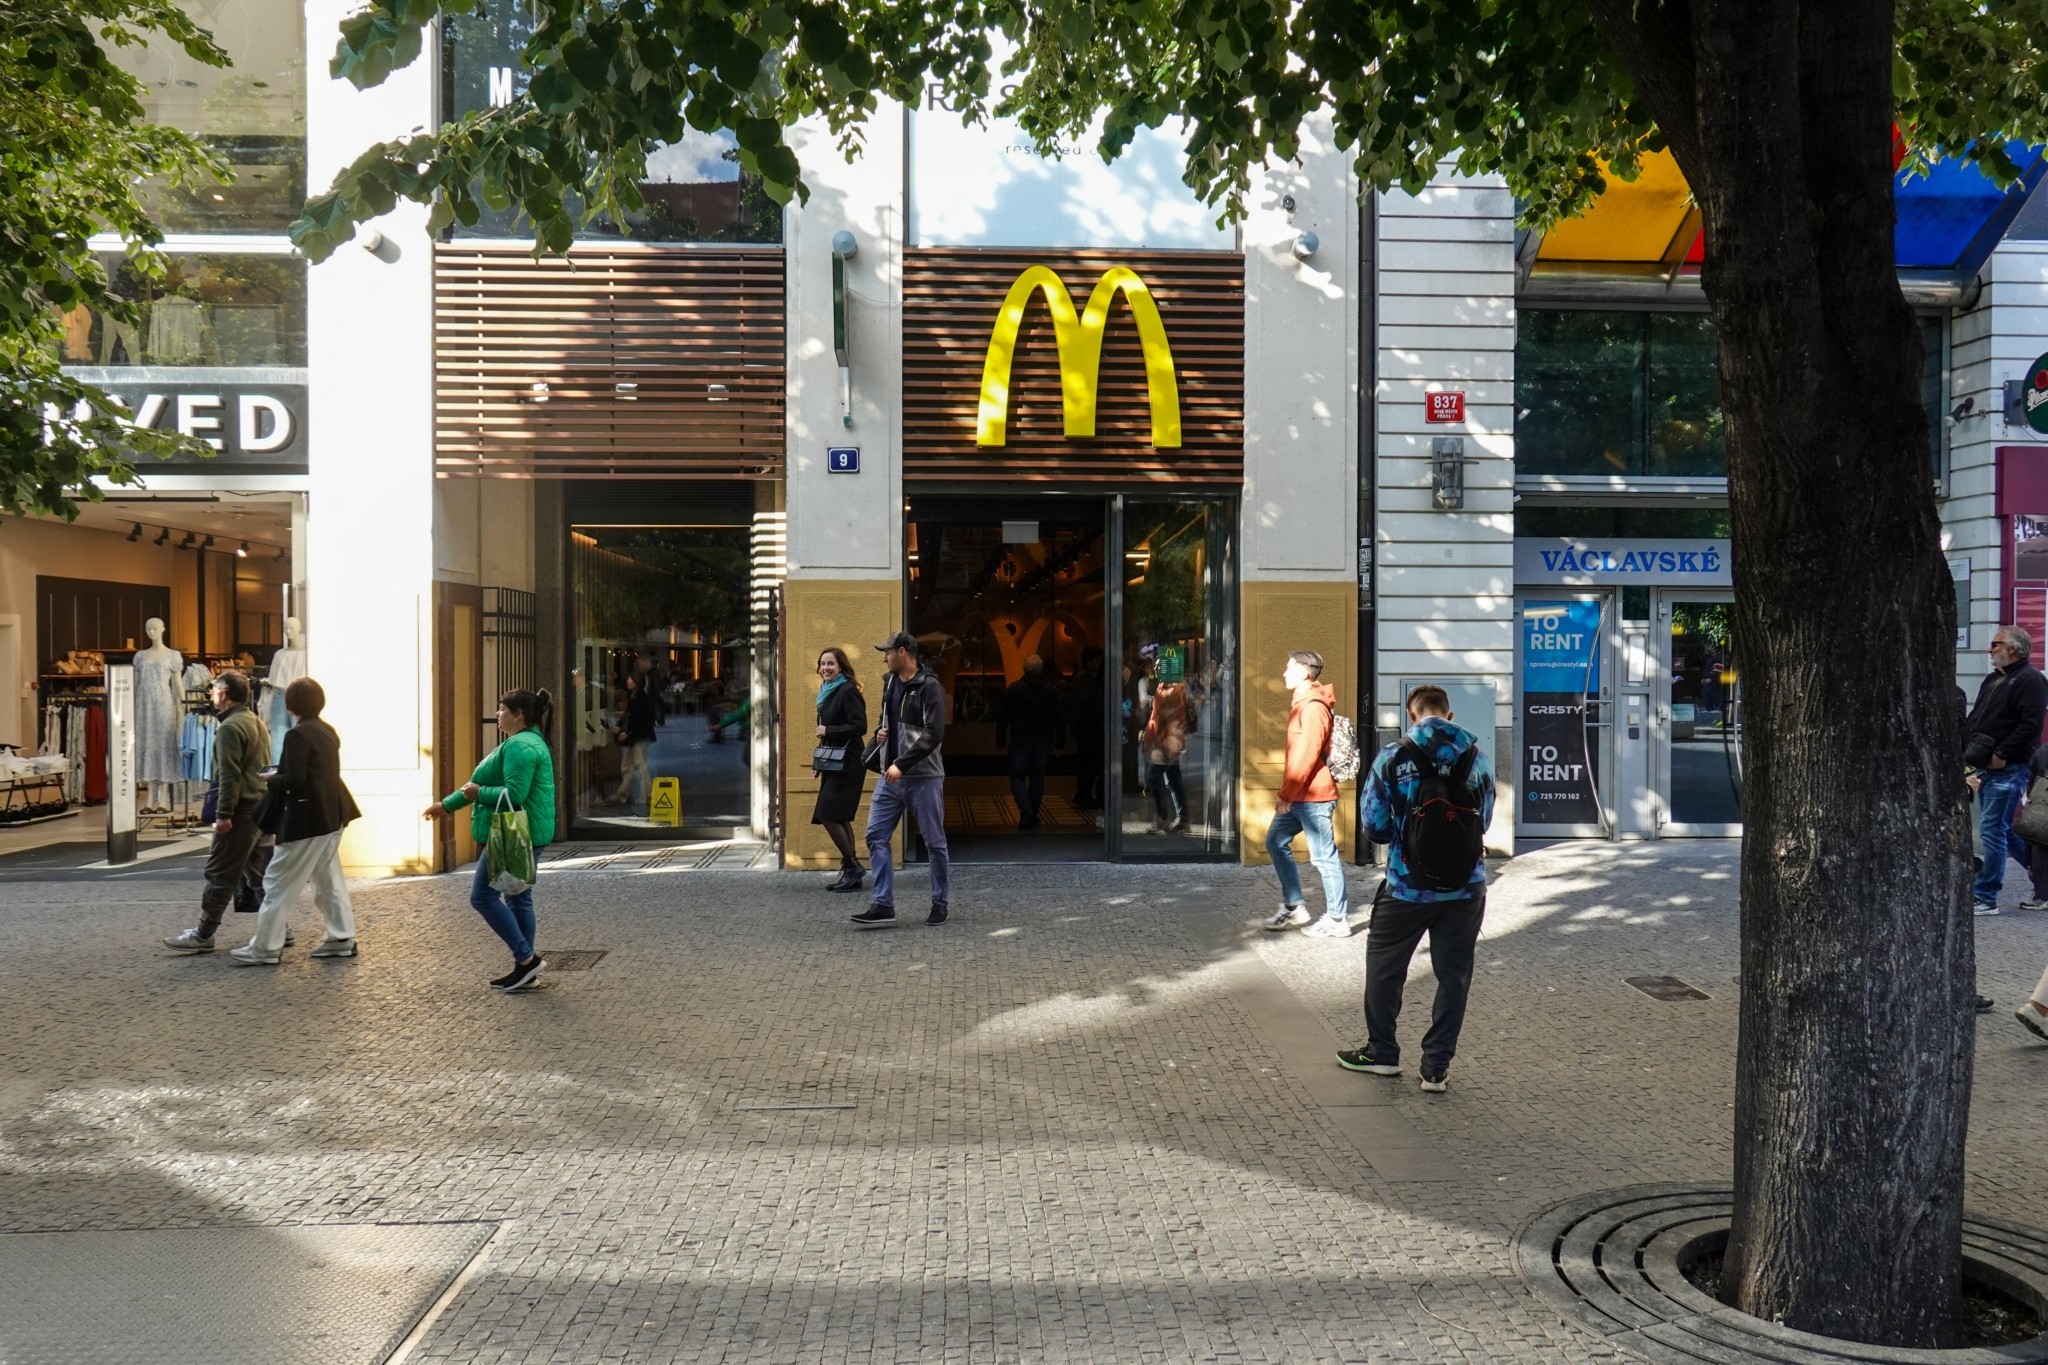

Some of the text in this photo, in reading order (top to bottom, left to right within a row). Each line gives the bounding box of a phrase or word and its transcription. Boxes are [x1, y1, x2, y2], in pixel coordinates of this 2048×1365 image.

[976, 265, 1182, 448] M
[1434, 396, 1458, 408] 837
[13, 394, 292, 450] RVED
[839, 453, 848, 467] 9
[1540, 545, 1720, 572] VÁCLAVSKÉ
[1531, 614, 1559, 631] TO
[1530, 634, 1584, 650] RENT
[1529, 746, 1558, 762] TO
[1530, 765, 1582, 780] RENT
